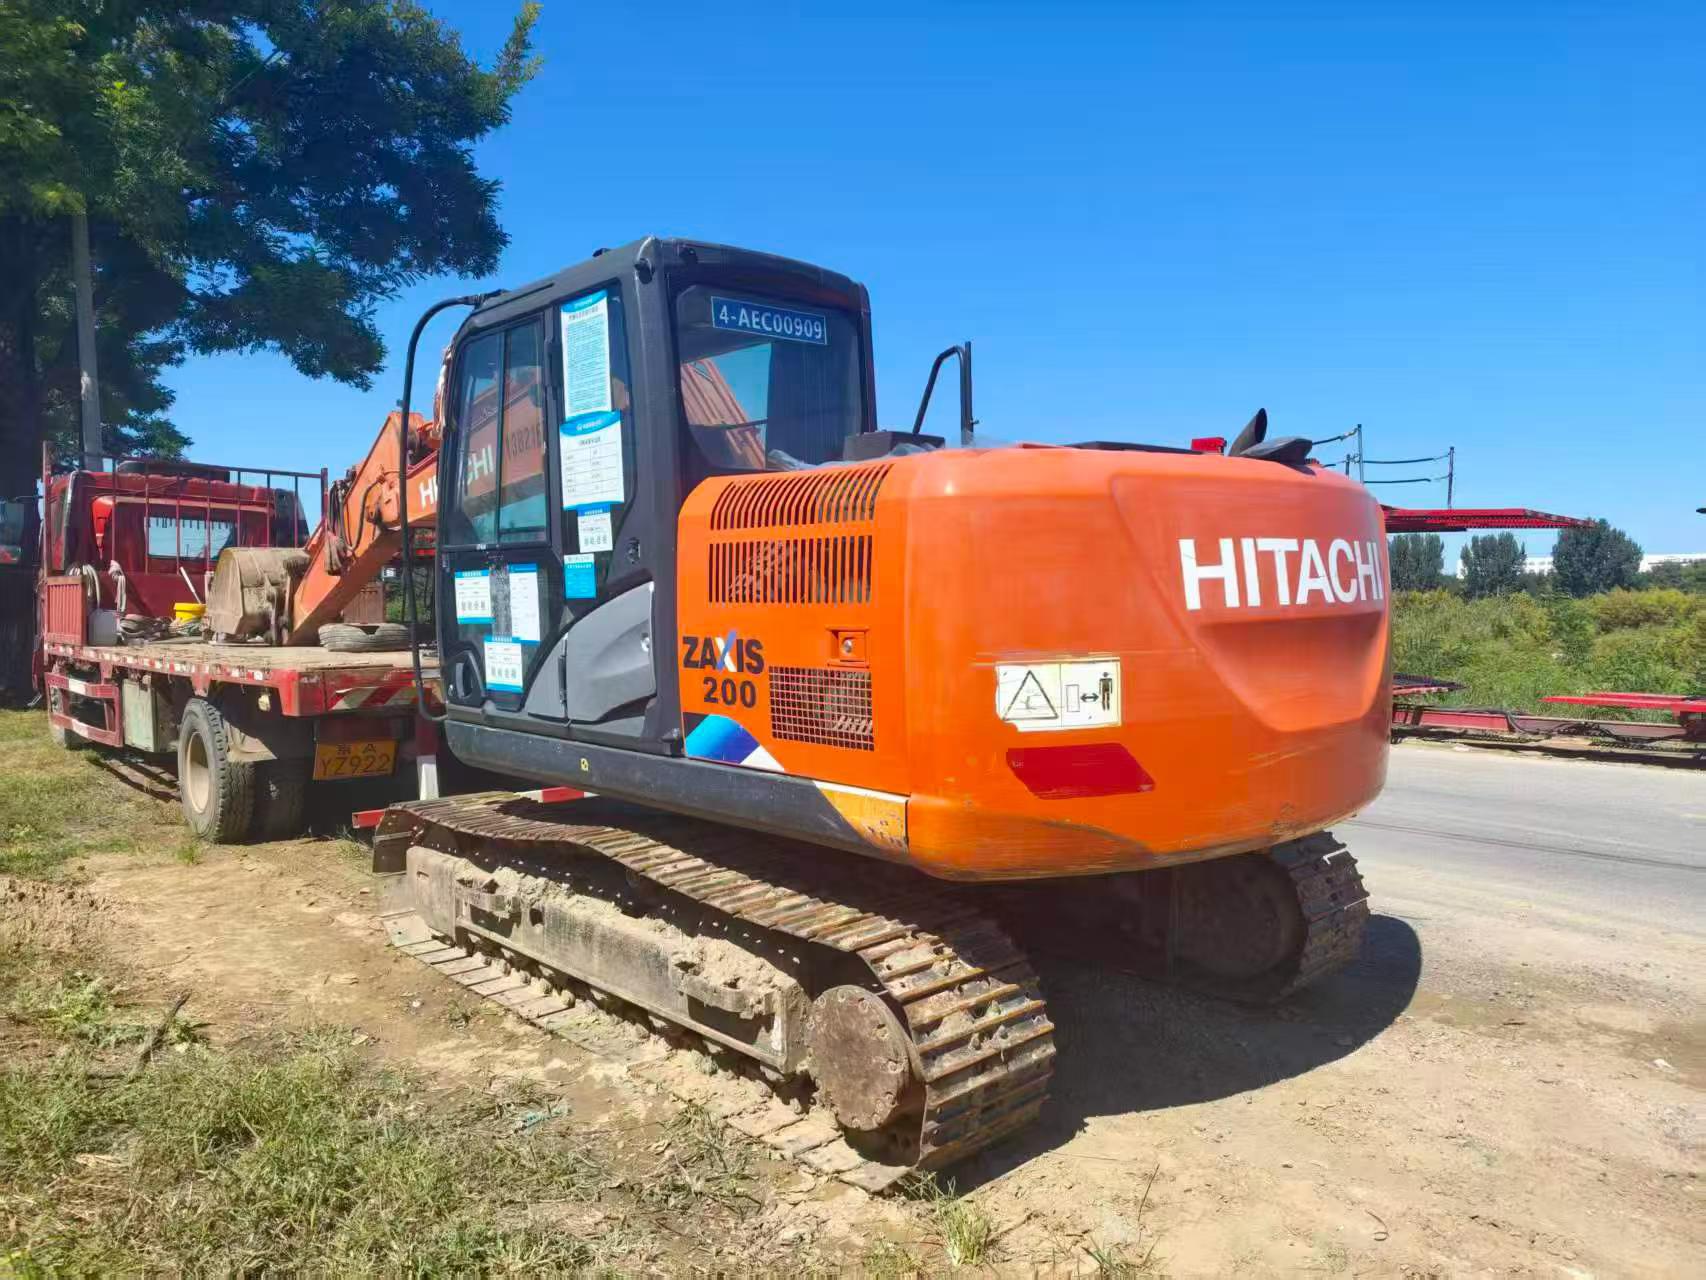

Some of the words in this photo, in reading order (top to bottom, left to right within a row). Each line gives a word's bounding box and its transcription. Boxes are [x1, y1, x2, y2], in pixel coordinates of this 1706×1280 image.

[719, 304, 822, 339] 4-AEC00909
[1179, 537, 1384, 611] HITACHI
[682, 631, 764, 675] ZAXIS
[703, 676, 756, 708] 200
[320, 752, 391, 777] YZ922
